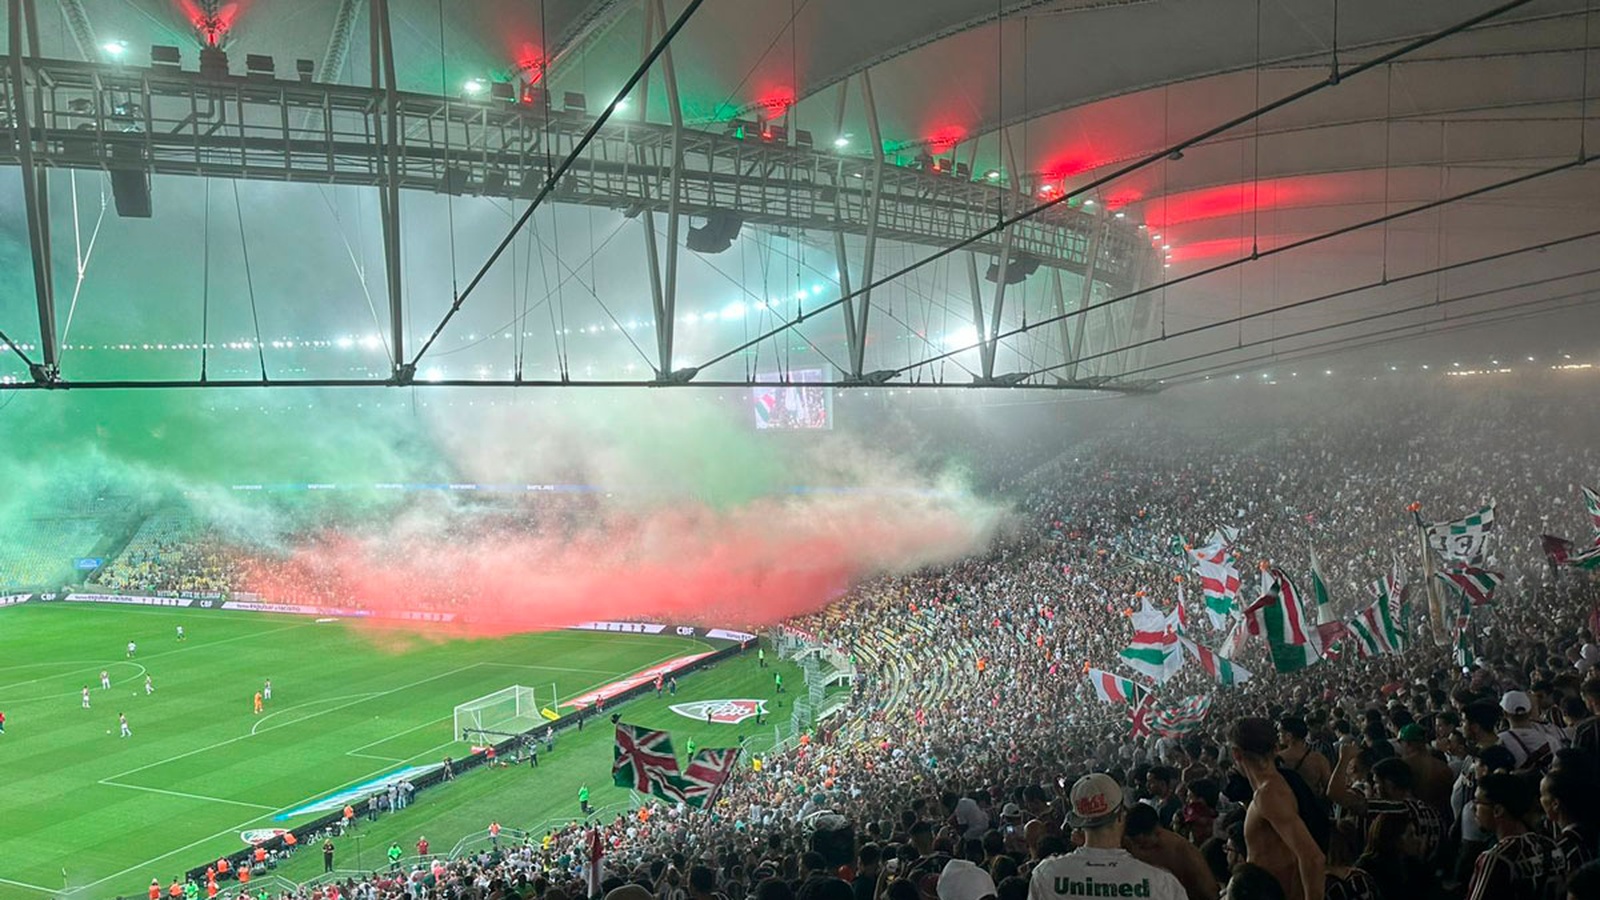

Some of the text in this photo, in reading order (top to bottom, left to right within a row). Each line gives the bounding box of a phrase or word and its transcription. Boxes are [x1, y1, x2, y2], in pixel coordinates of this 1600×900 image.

[40, 593, 57, 601] CBF
[676, 626, 694, 635] CBF
[1054, 877, 1151, 898] Unimed
